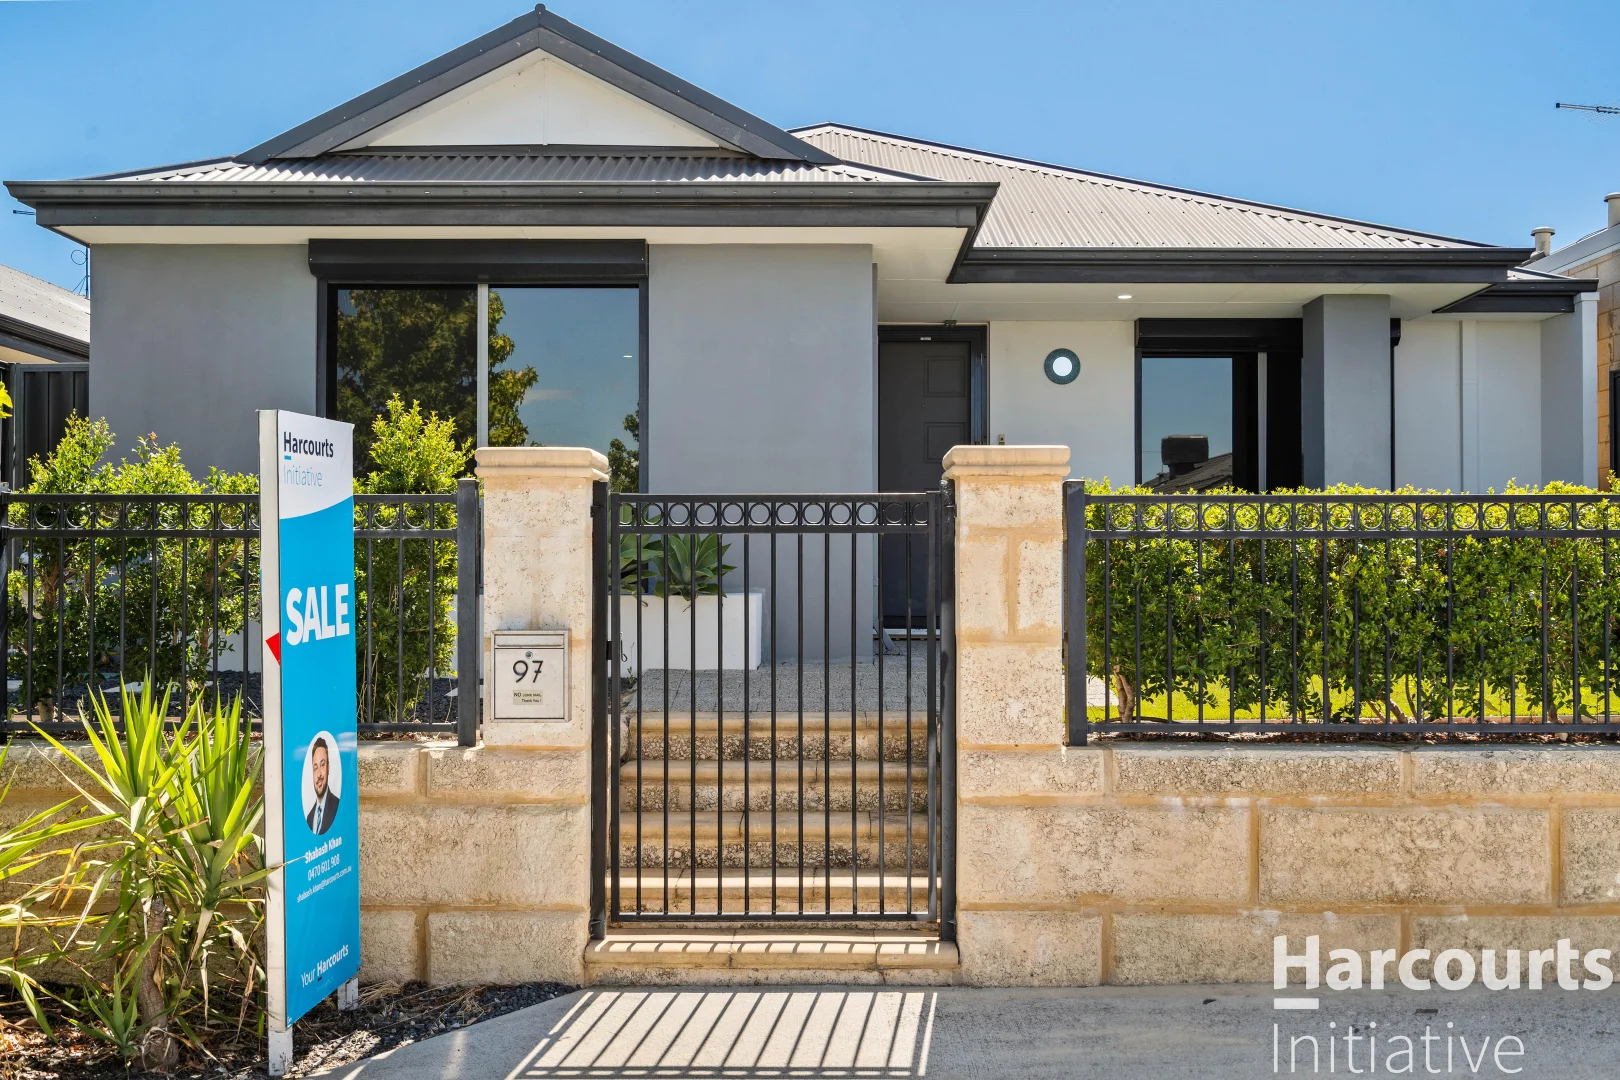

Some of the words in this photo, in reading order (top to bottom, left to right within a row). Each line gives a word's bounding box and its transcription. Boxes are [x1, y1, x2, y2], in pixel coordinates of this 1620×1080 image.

[283, 431, 334, 458] Harcourts
[283, 464, 323, 487] Initiative
[285, 583, 350, 646] SALE
[512, 660, 544, 684] 97
[328, 836, 342, 851] Khan
[307, 864, 321, 881] 0470
[300, 968, 316, 988] Your
[316, 944, 349, 977] Harcourts
